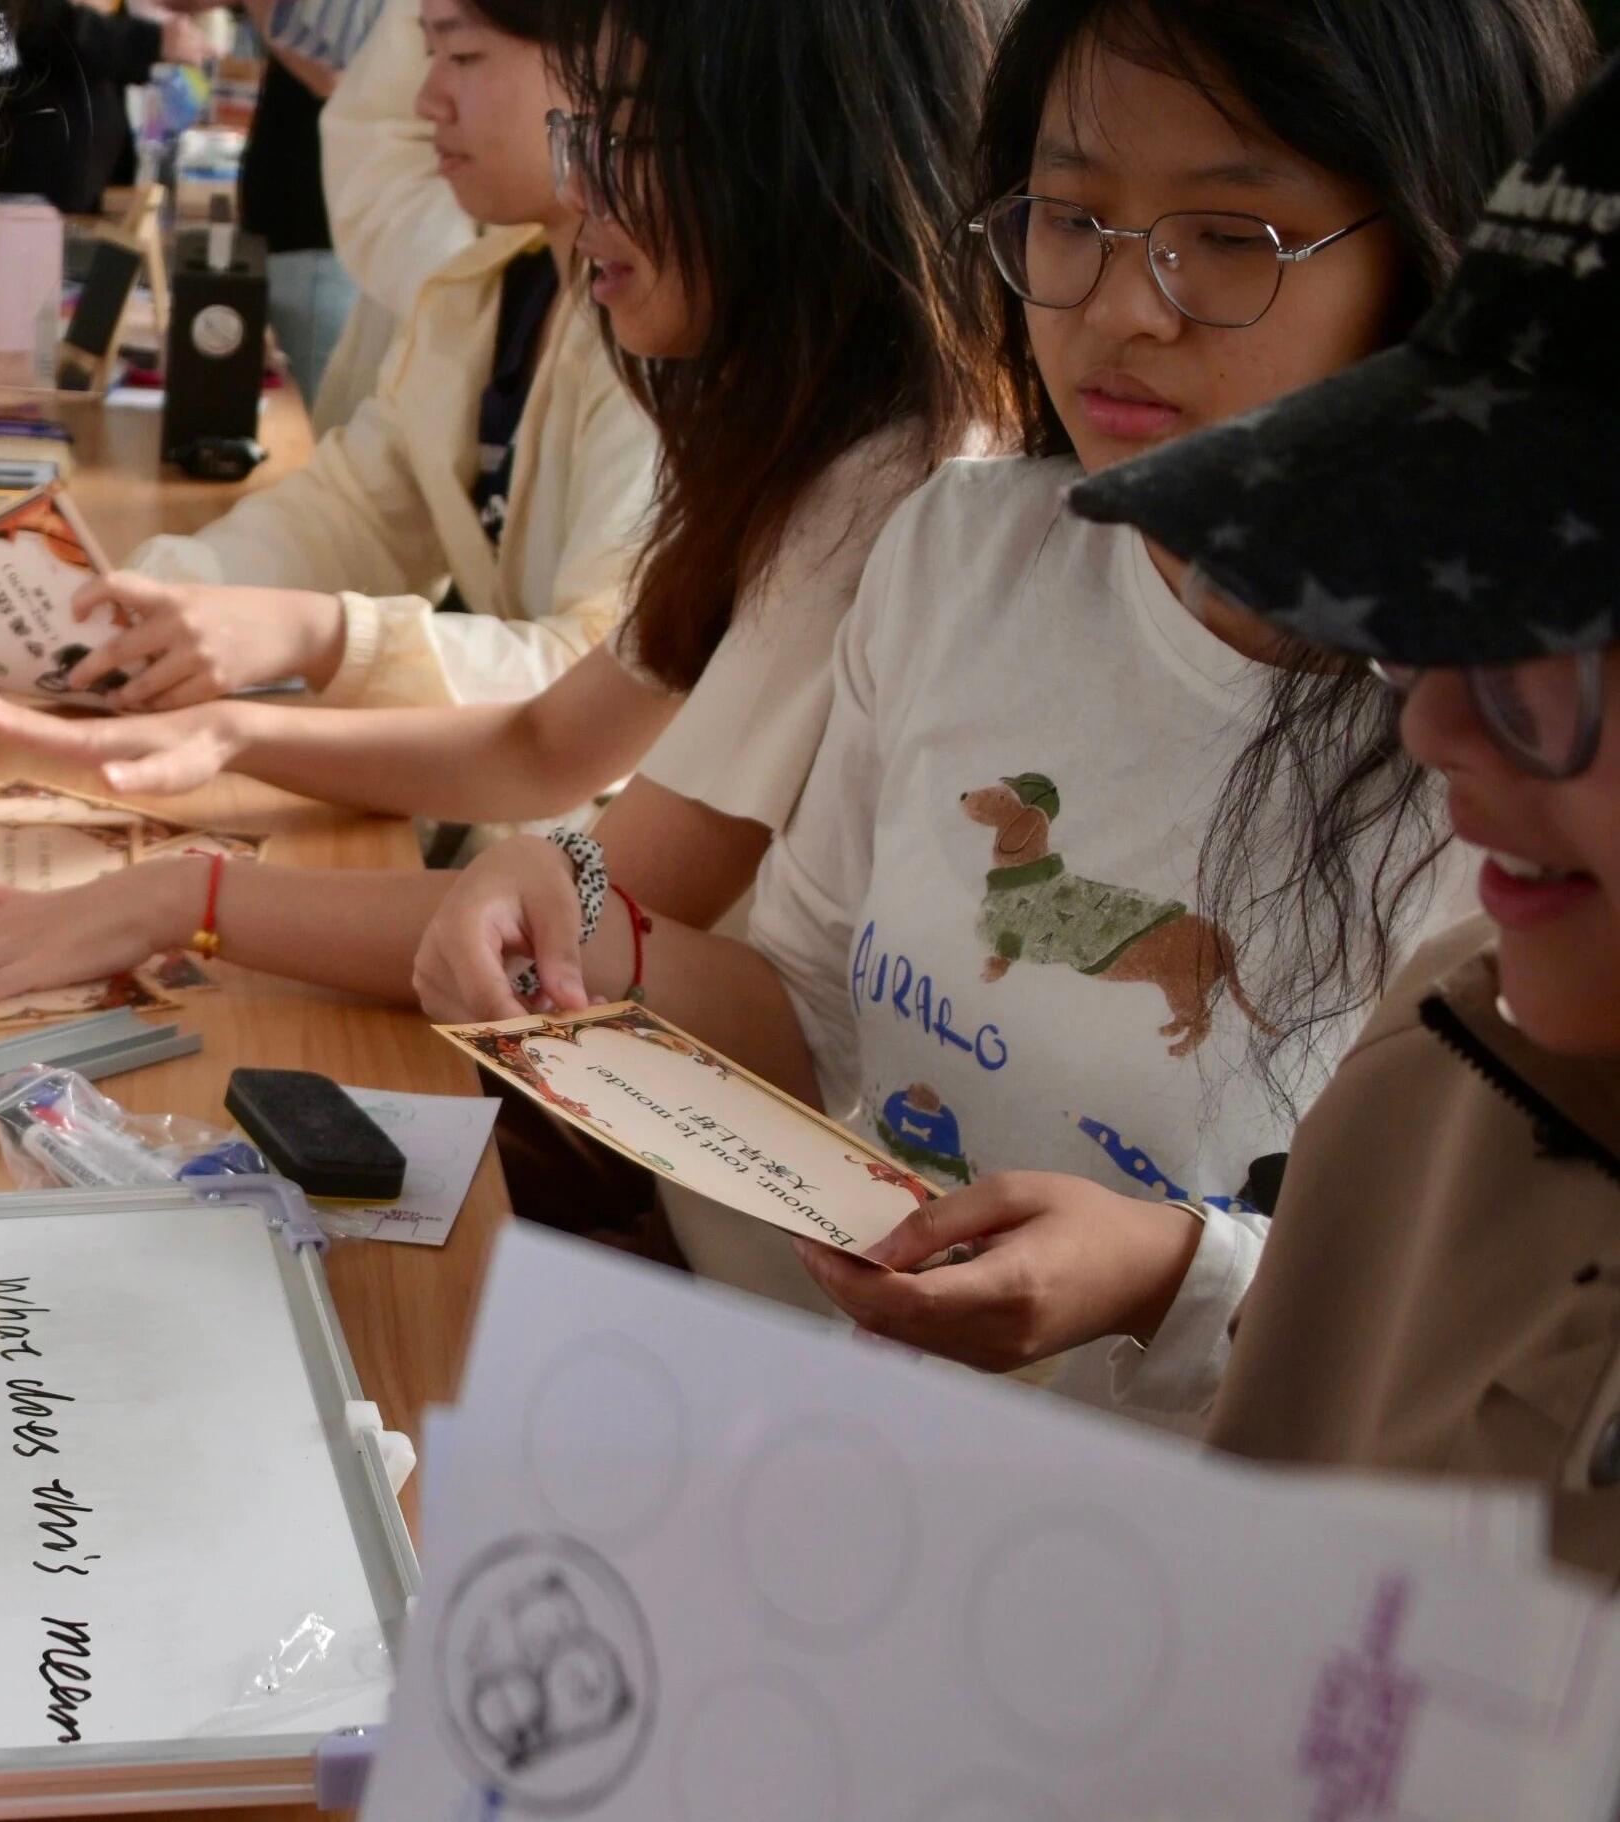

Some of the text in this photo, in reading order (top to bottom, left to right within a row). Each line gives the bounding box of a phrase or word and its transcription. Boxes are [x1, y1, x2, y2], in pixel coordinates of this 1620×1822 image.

[585, 1063, 857, 1247] Bonjour, tout le monde!
[7, 1380, 76, 1458] does
[32, 1478, 101, 1576] this
